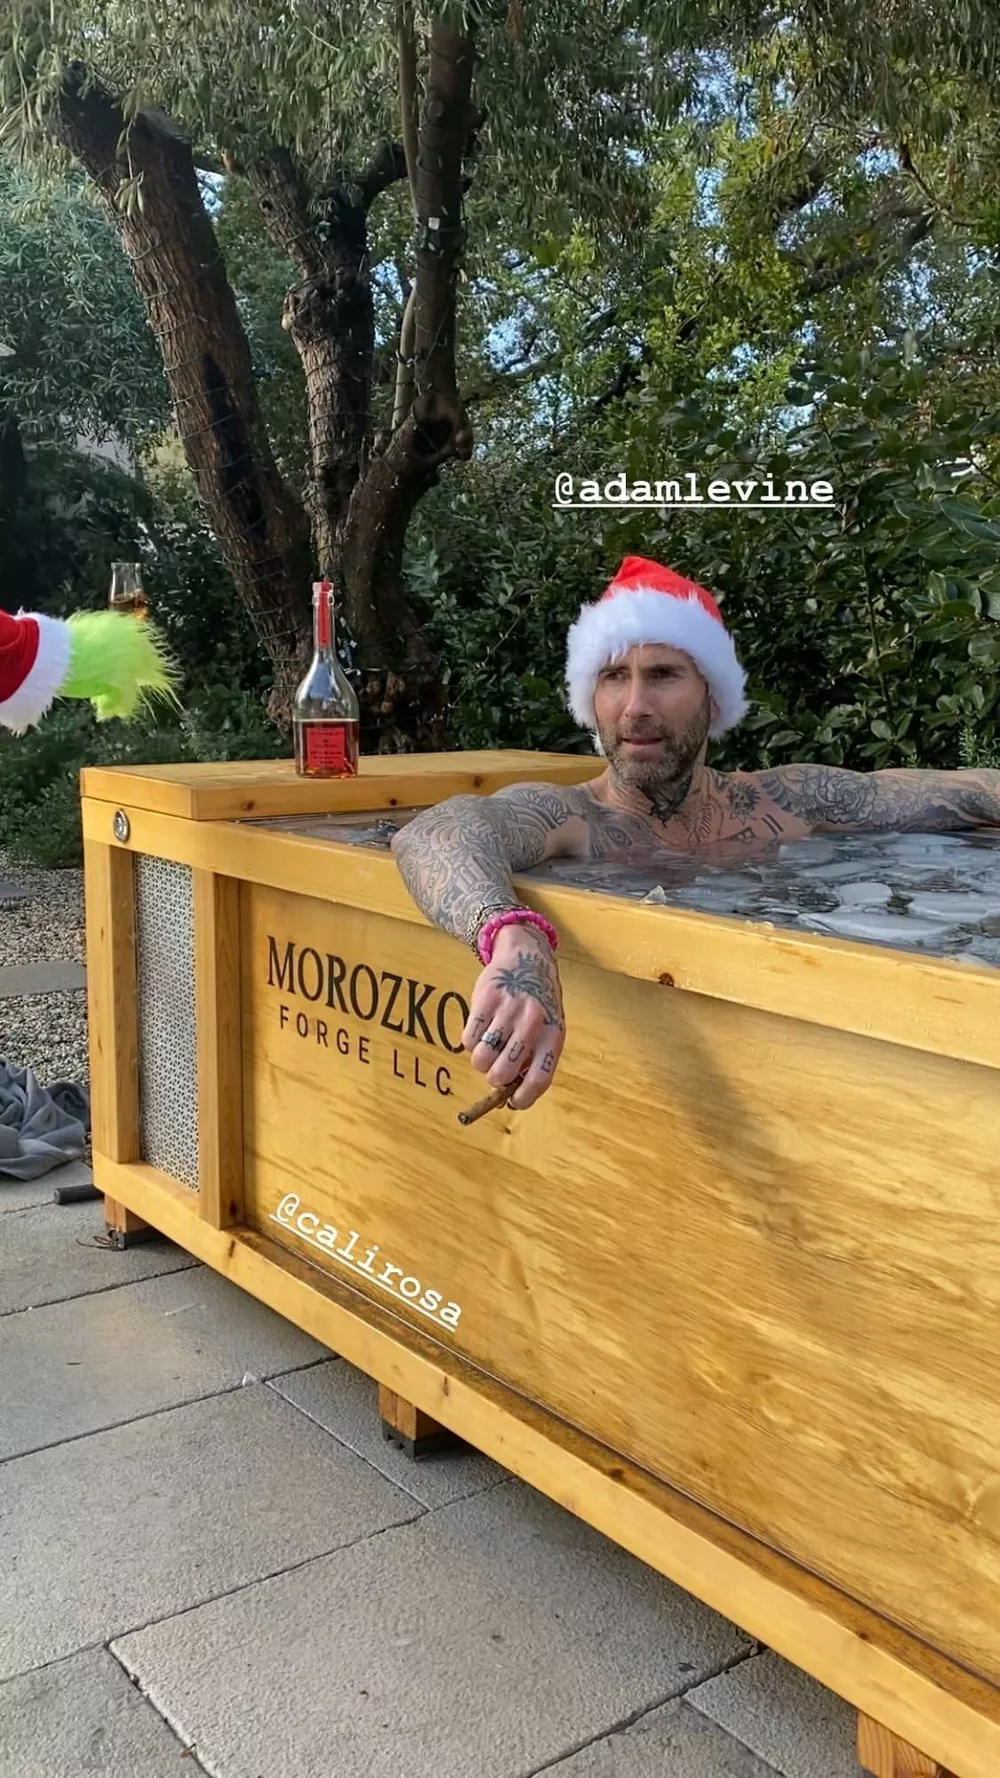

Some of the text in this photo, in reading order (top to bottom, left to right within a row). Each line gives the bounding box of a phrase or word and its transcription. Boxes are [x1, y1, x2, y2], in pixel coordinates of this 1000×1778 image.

[266, 935, 470, 1054] MOROZKO
[279, 1004, 453, 1096] FORGE LLC
